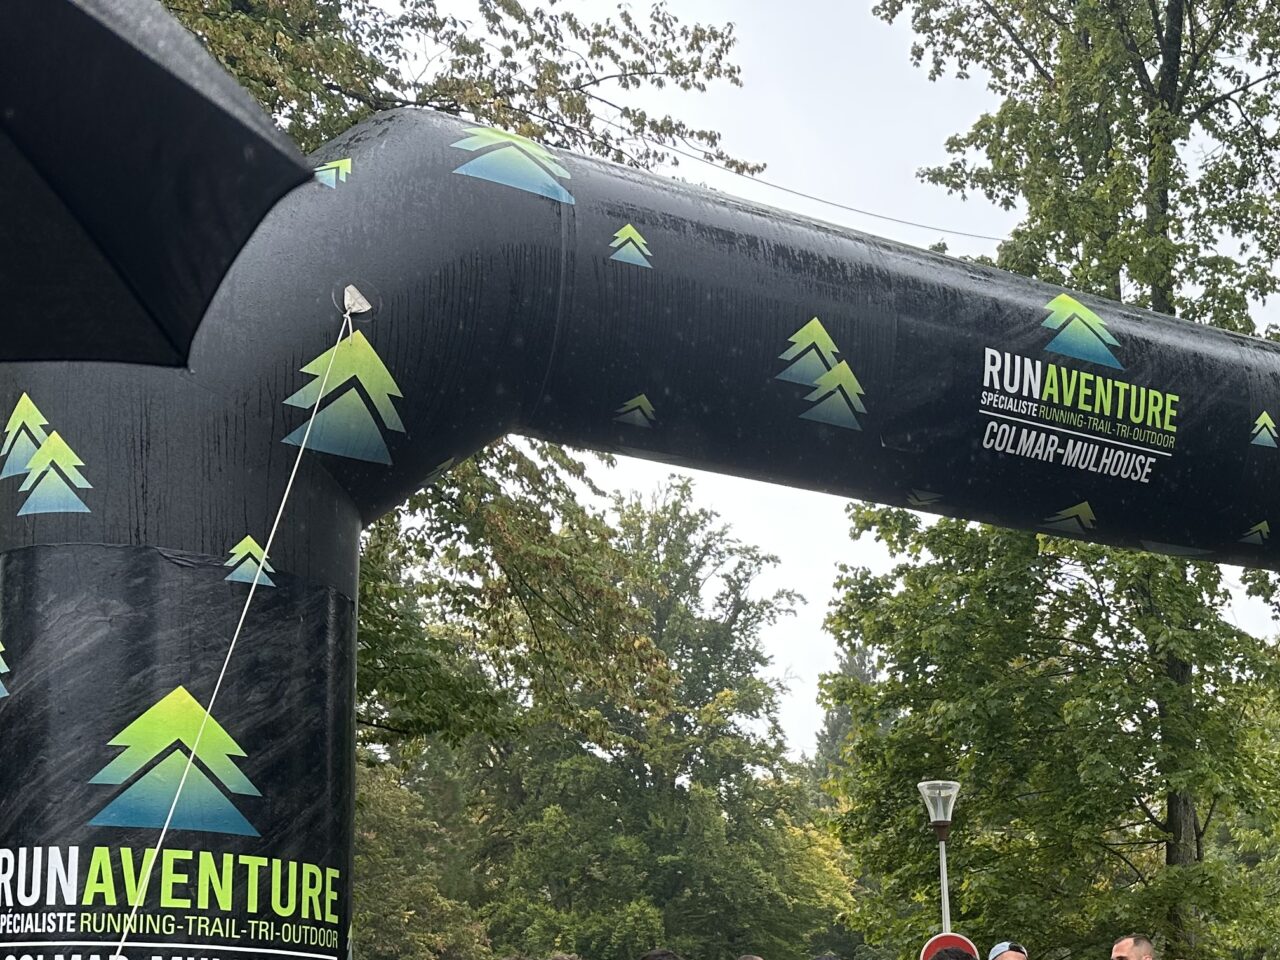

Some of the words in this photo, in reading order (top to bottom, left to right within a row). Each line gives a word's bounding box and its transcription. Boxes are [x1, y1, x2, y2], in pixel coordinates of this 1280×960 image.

[980, 390, 1038, 417] SPÉCIALISTE
[1038, 404, 1176, 449] RUNNING-TRAIL-TRI-OUTDOOR
[983, 347, 1180, 433] RUNAVENTURE
[982, 421, 1156, 484] COLMAR-MULHOUSE
[0, 845, 340, 924] RUNAVENTURE
[0, 908, 76, 934] PÉCIALISTE
[80, 912, 339, 949] RUNNING-TRAIL-TRI-OUTDOOR
